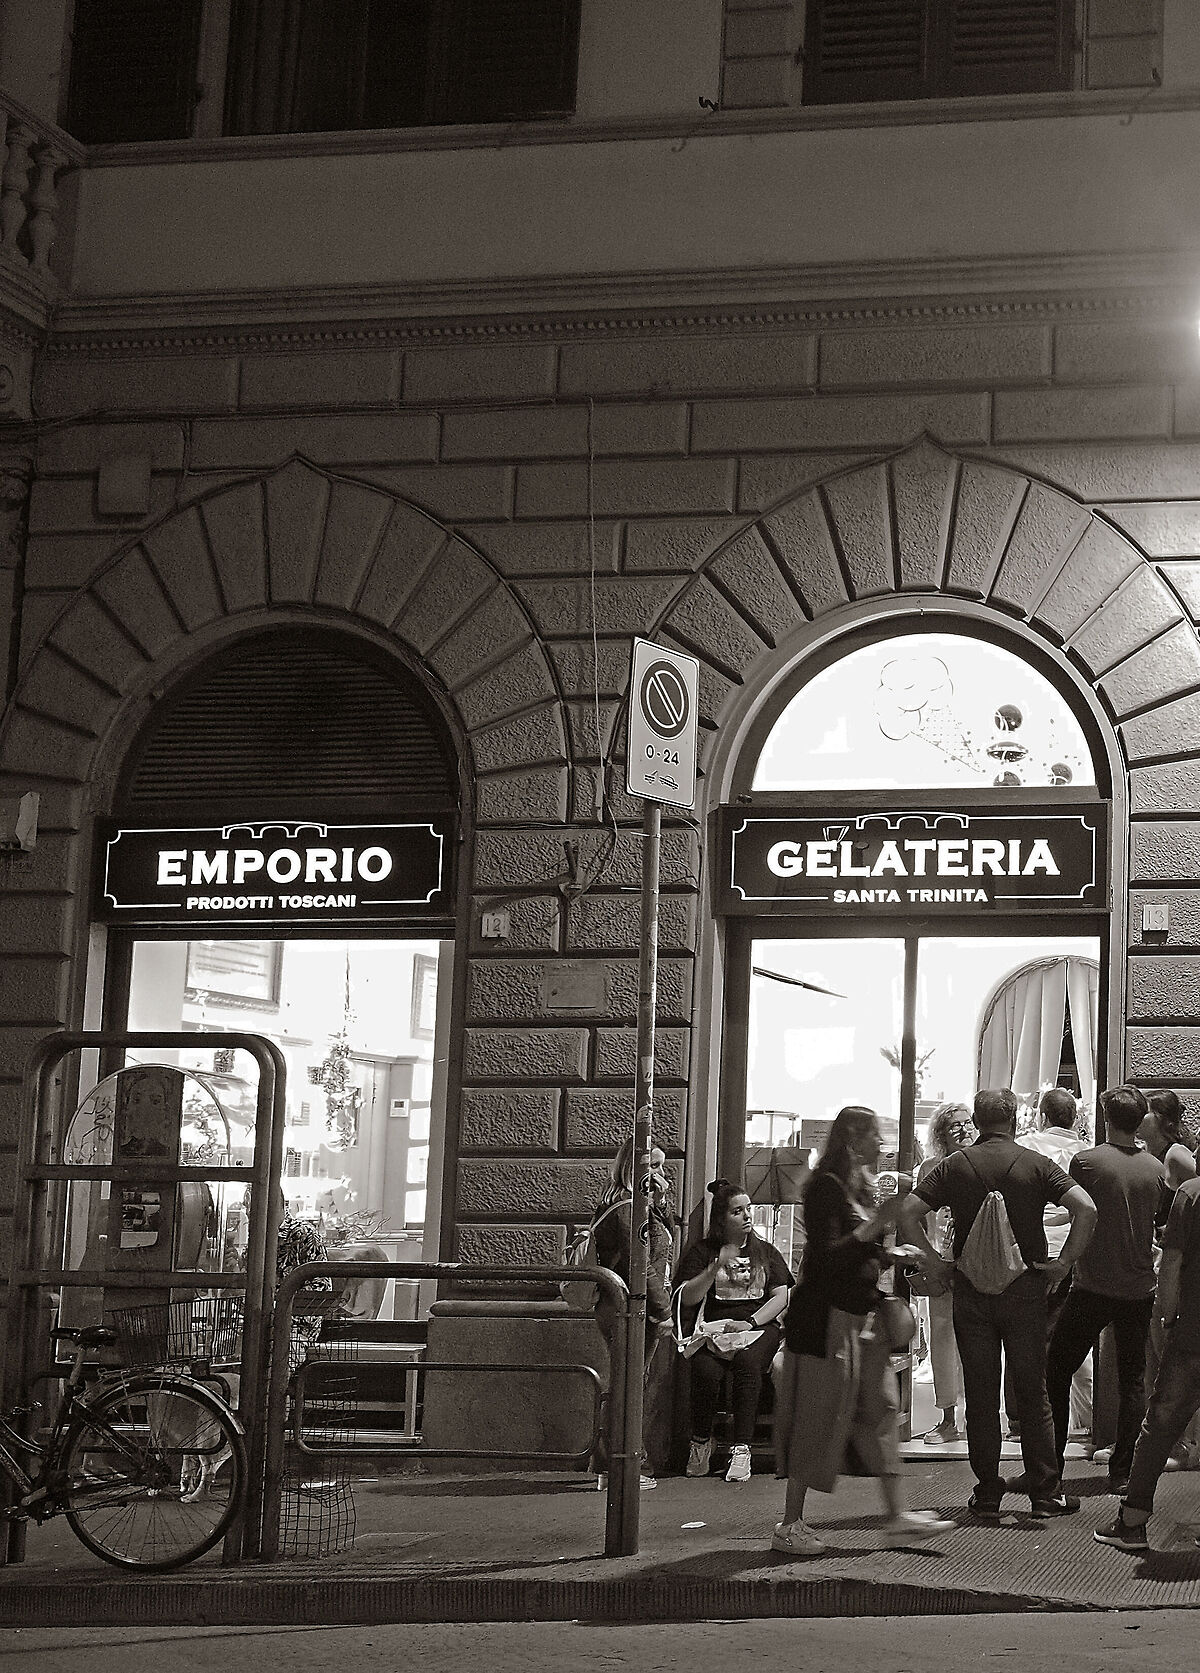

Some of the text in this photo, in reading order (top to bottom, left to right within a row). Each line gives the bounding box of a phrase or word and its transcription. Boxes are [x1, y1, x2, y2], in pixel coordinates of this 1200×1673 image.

[156, 846, 393, 886] EMPORIO
[766, 838, 1061, 879] GELATERIA
[186, 894, 357, 910] PRODOTTI TOSCANI
[833, 888, 989, 904] SANTA TRINITA
[1148, 909, 1165, 925] 13
